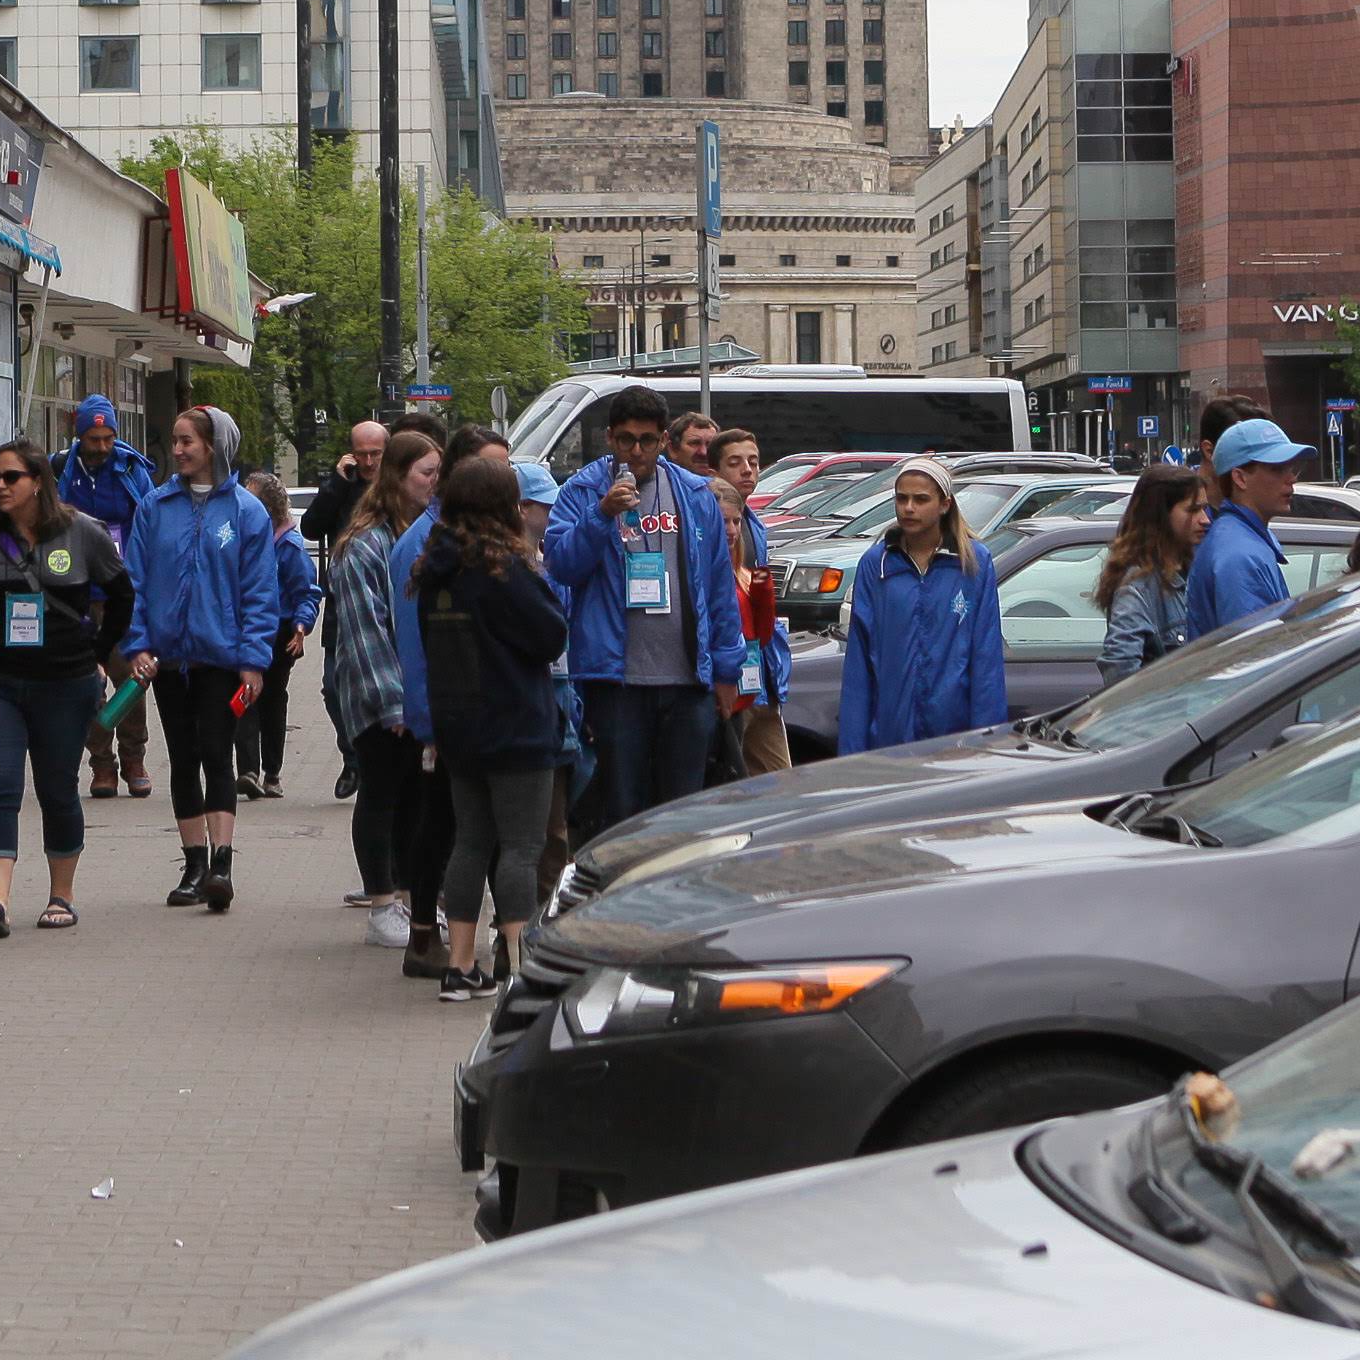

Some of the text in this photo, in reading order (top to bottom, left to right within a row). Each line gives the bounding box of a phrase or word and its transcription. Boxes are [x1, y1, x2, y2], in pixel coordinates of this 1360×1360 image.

[1272, 303, 1334, 323] VAN
[863, 362, 912, 371] RESTAURACJA
[1142, 418, 1154, 435] P
